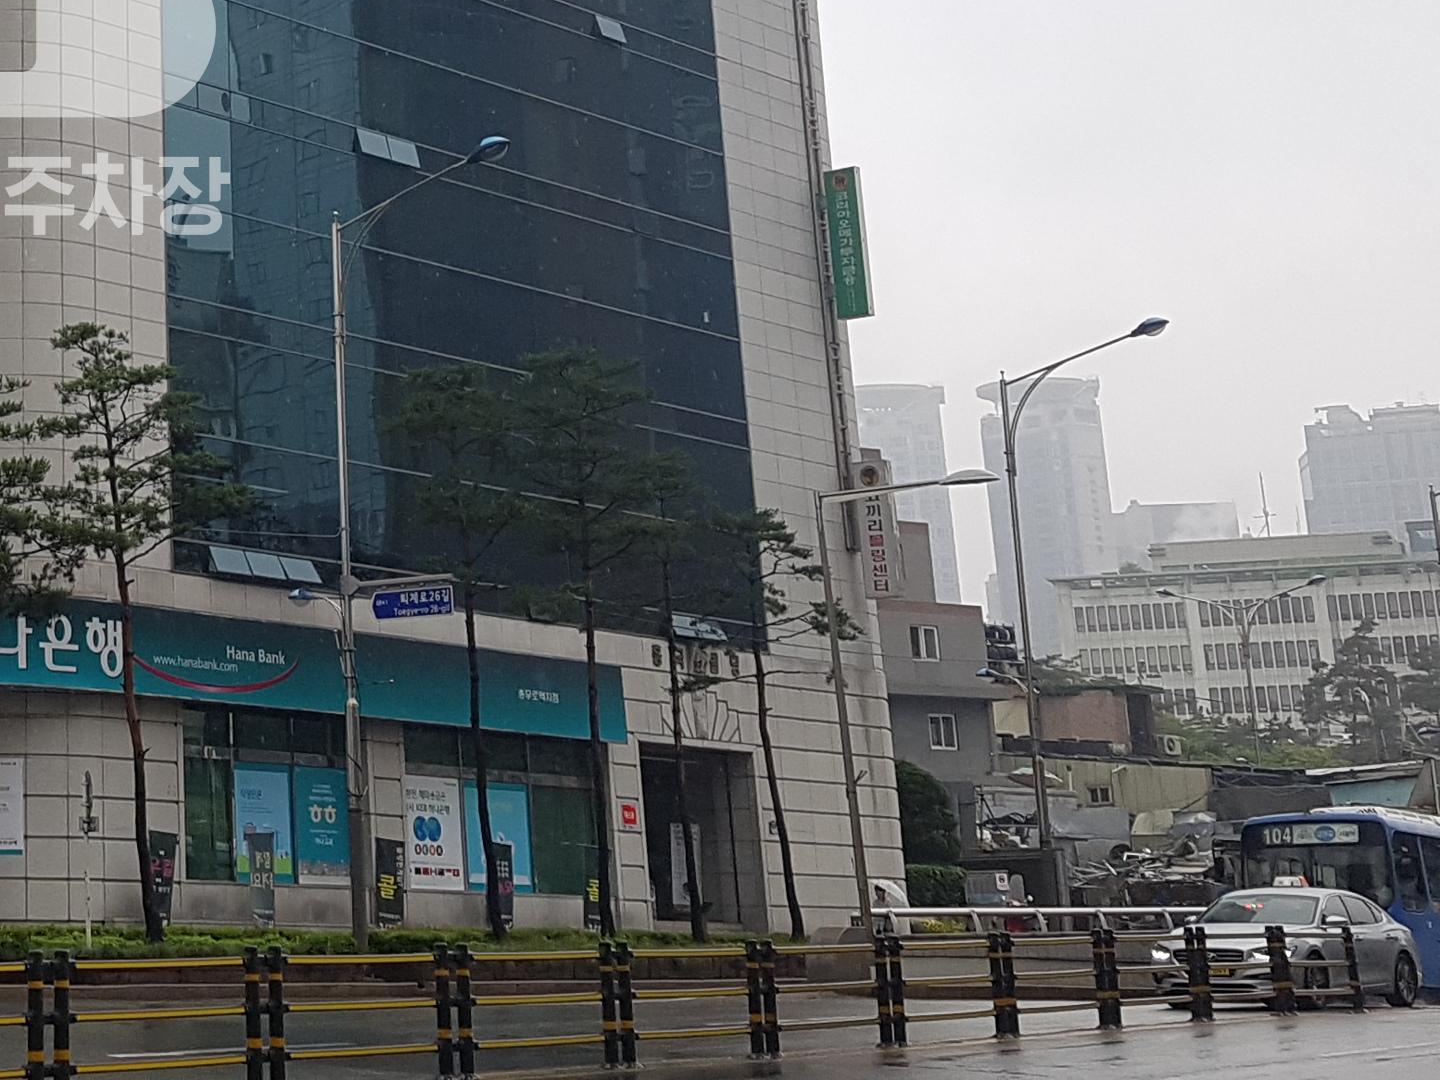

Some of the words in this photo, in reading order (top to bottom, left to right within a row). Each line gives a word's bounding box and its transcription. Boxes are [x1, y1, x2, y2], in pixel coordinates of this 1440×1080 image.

[152, 655, 239, 673] www.hanabank.com
[226, 645, 256, 662] Hana
[258, 649, 286, 665] Bank
[1263, 827, 1292, 845] 104
